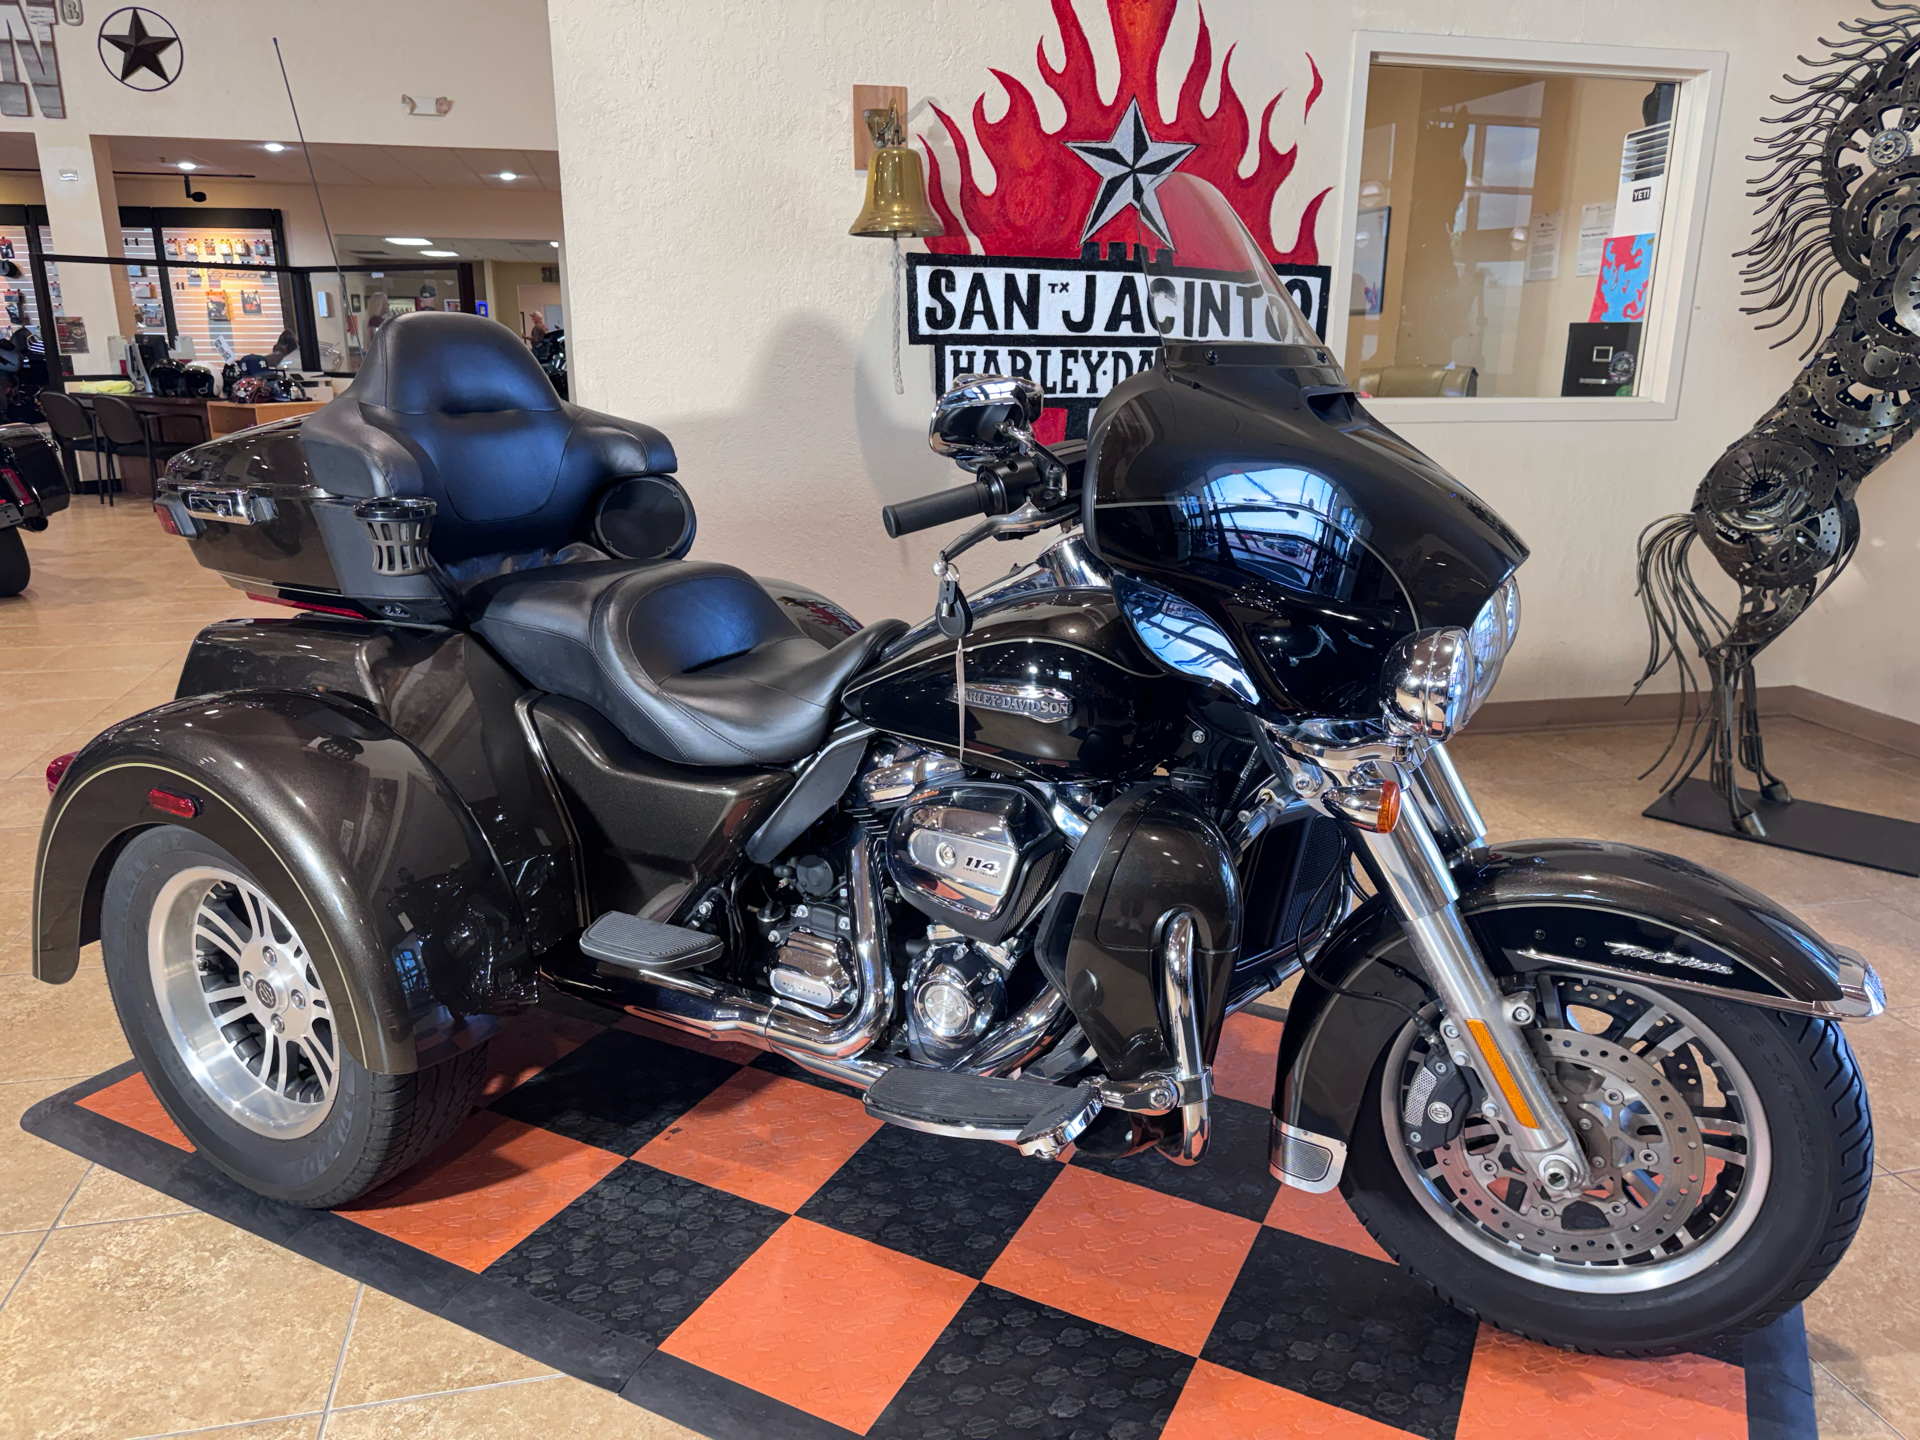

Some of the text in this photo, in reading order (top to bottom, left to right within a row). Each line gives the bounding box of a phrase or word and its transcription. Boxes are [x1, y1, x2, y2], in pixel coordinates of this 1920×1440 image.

[1633, 188, 1651, 201] YETI
[925, 269, 1312, 342] SAN TX JACINTO
[965, 857, 998, 871] 114
